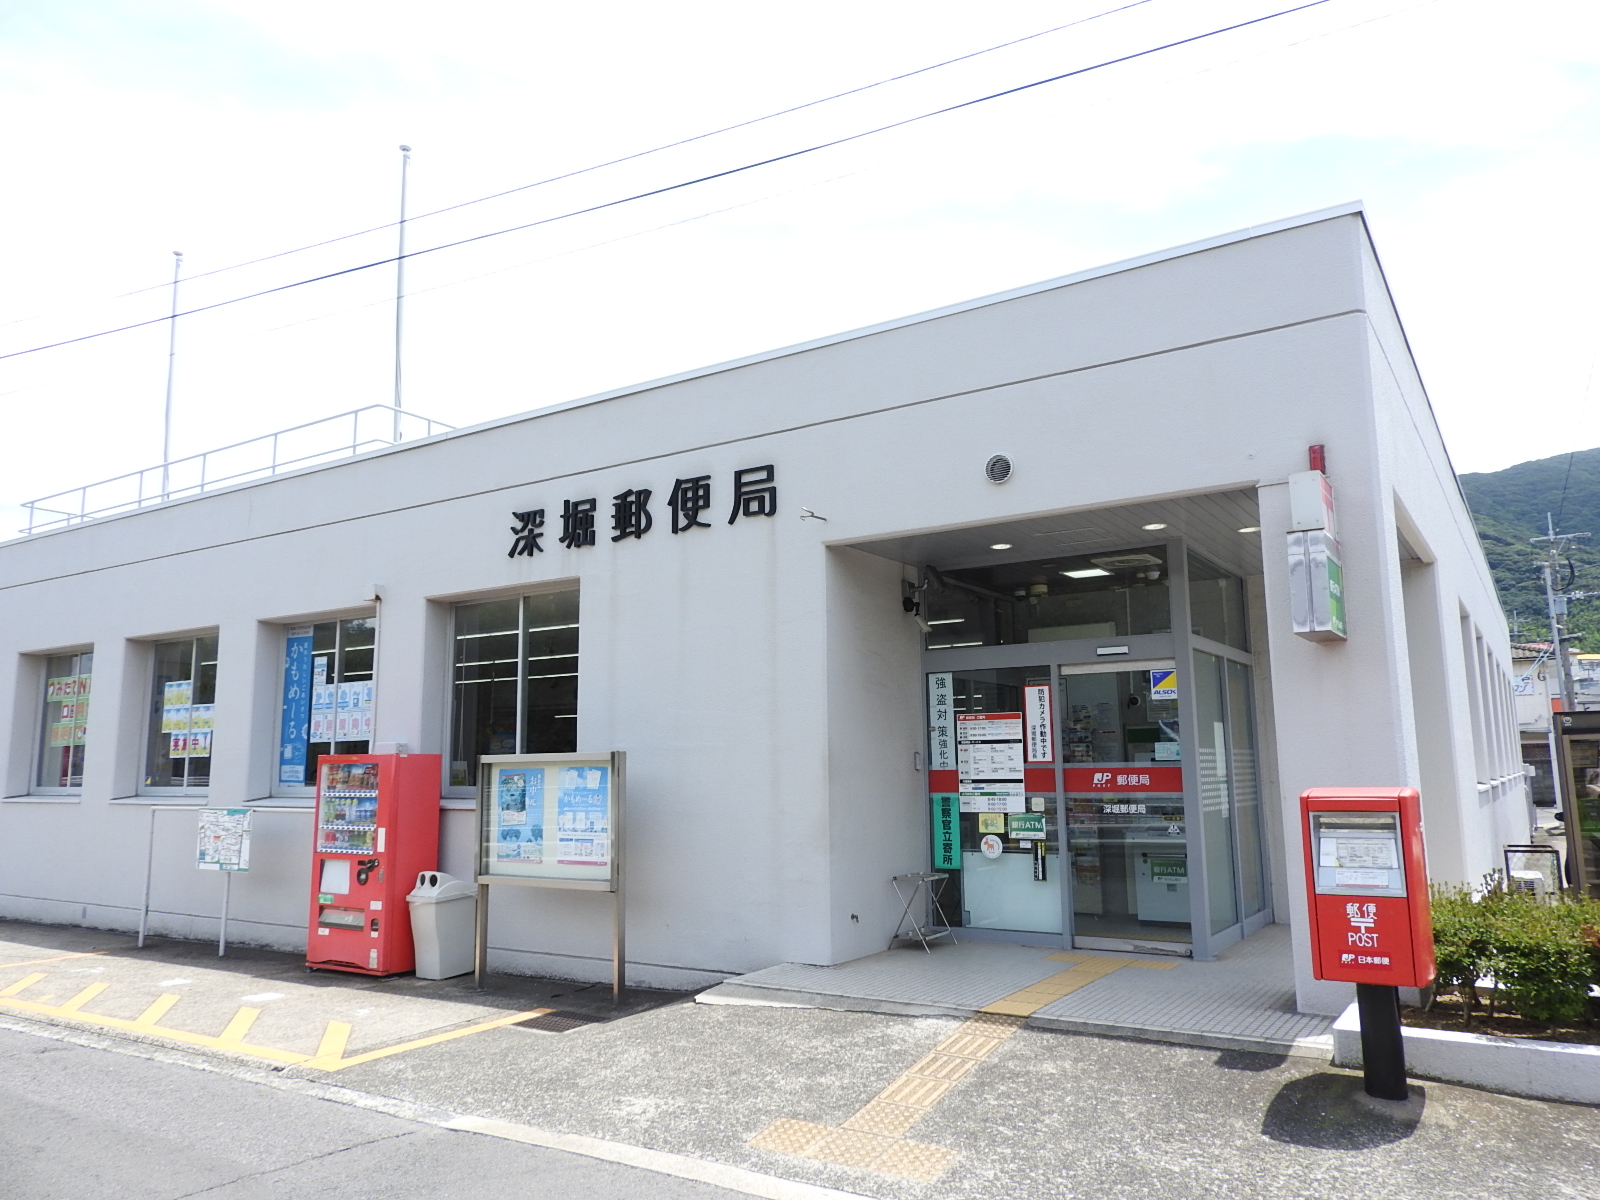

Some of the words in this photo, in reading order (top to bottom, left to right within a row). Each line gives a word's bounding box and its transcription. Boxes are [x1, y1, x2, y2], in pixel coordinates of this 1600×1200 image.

[508, 464, 777, 558] 深堀郵便局
[935, 677, 949, 768] 強盗対策強化中
[1037, 688, 1047, 759] 防犯カメラ作動中です
[1116, 774, 1150, 785] 郵便局
[1103, 804, 1146, 814] 深堀郵便局
[941, 796, 953, 866] 警察官立寄所
[1011, 821, 1043, 829] 銀行ATM
[1153, 866, 1184, 874] 銀行ATM
[1346, 902, 1377, 920] 郵便
[1348, 932, 1379, 947] POST
[1357, 956, 1390, 965] 日本郵便
